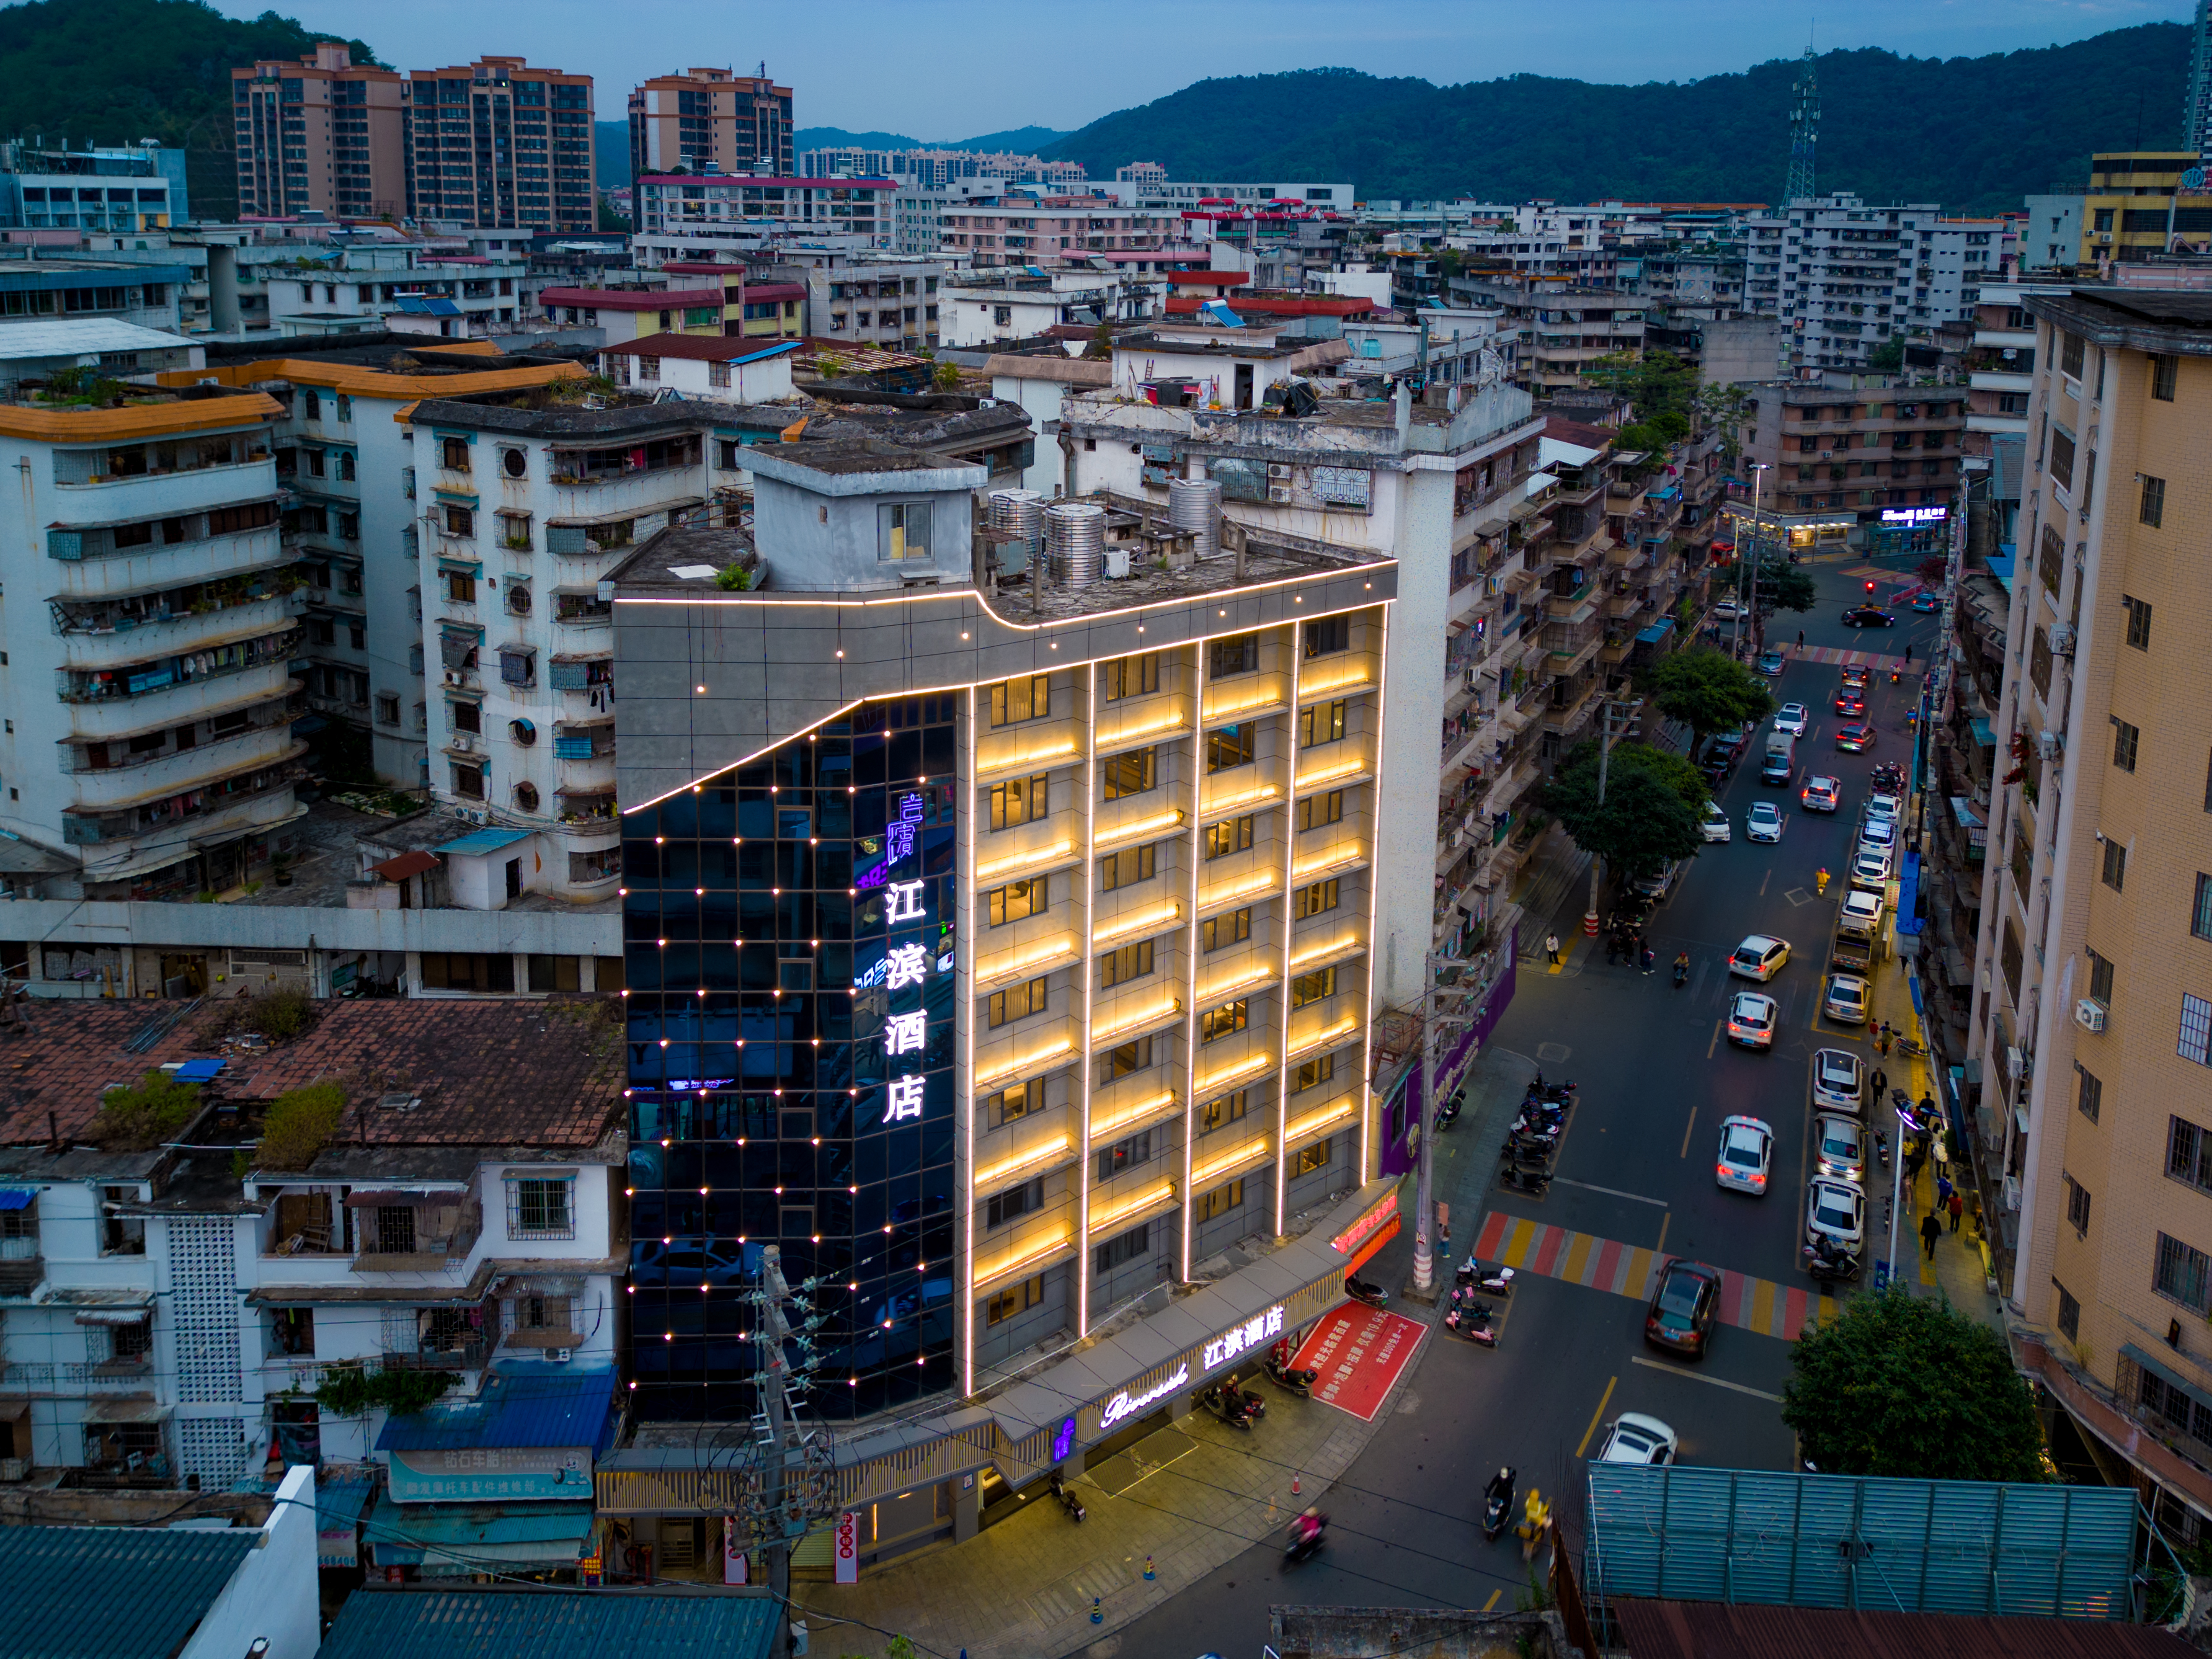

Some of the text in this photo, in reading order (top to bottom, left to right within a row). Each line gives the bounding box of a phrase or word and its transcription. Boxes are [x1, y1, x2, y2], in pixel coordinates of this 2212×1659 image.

[882, 879, 927, 1123] 江滨酒店
[1204, 1306, 1283, 1369] 江滨酒店
[445, 1450, 499, 1469] 钻石车胎
